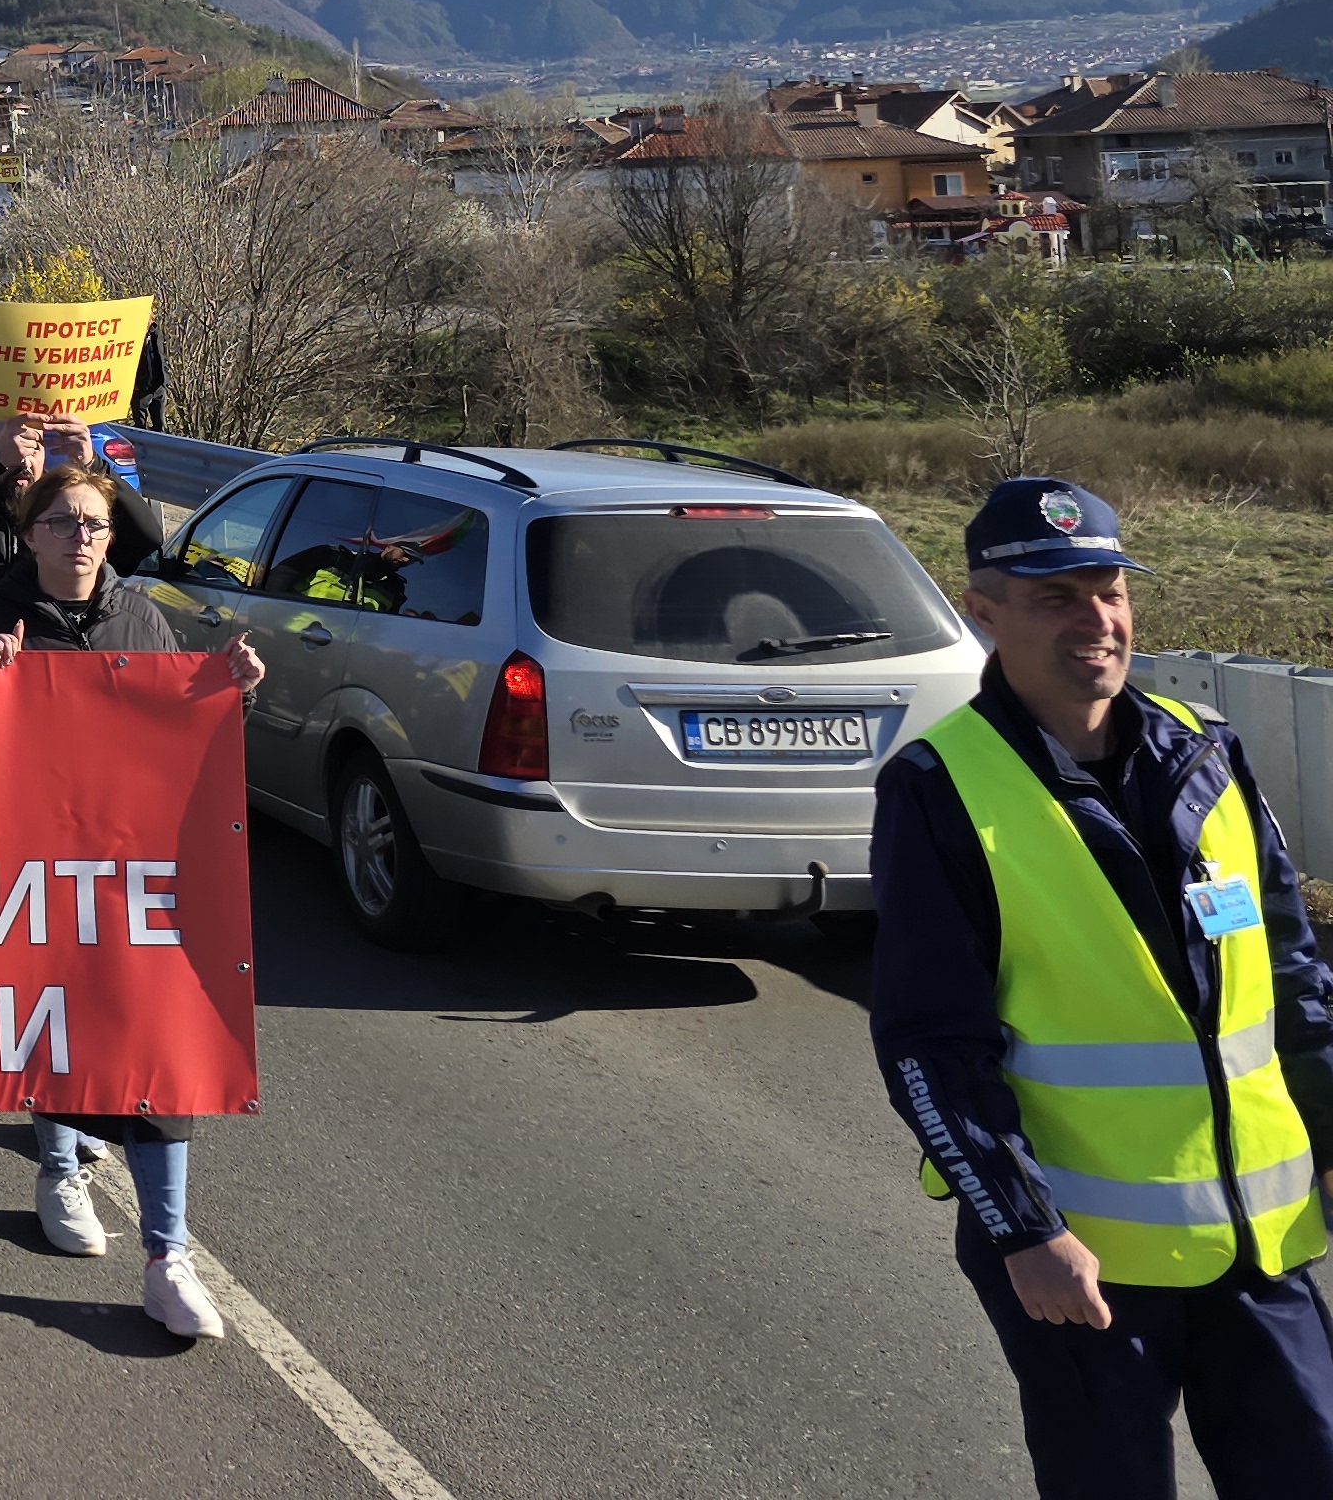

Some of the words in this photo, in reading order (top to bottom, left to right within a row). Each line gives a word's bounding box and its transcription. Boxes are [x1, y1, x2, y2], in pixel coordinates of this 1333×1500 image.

[26, 318, 122, 339] ПРОТЕСТ
[33, 340, 135, 364] УБИВАЙТЕ
[16, 368, 112, 390] ТУРИЗМА
[16, 390, 120, 415] БЪЛГАРИЯ
[748, 717, 818, 747] 8998
[896, 1056, 965, 1160] SECURITY
[947, 1160, 1014, 1238] POLICE
